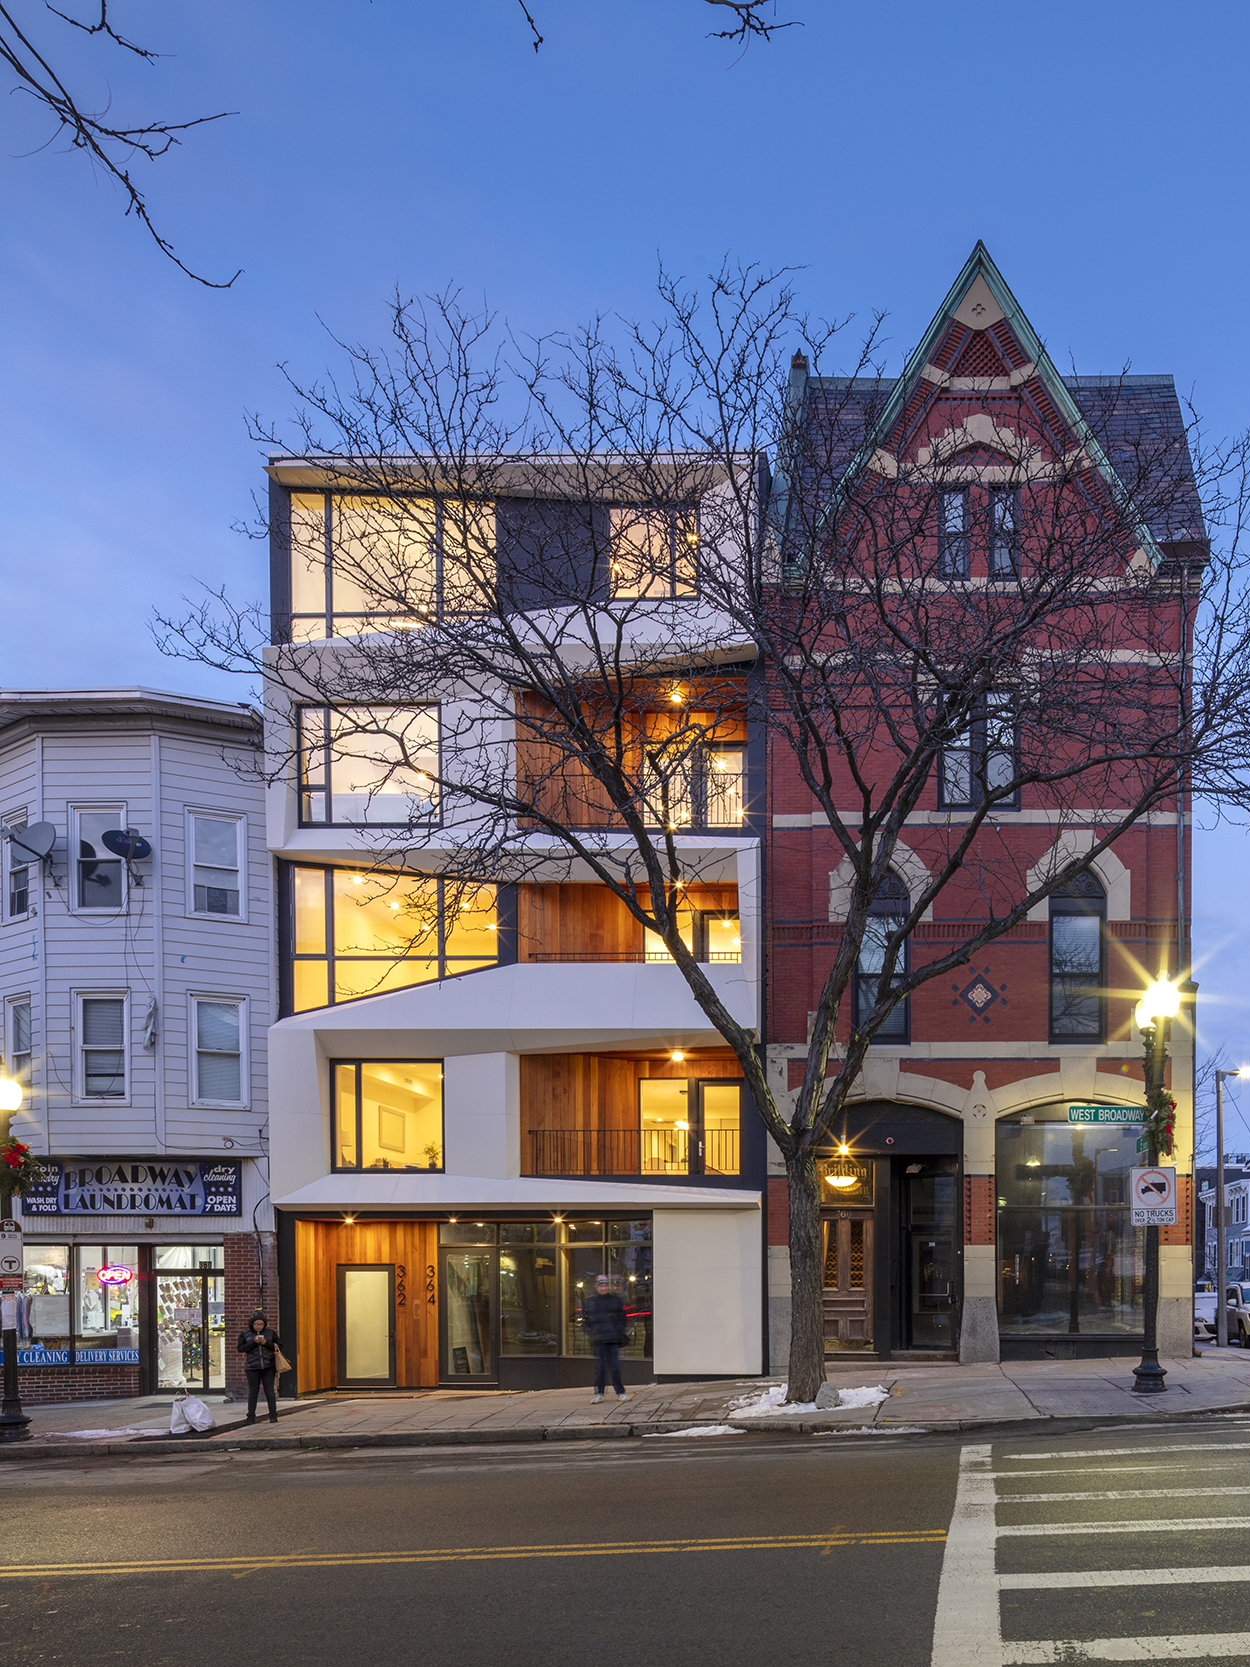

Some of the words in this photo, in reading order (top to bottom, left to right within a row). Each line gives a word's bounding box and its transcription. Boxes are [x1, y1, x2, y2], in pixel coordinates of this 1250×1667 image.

[1071, 1109, 1095, 1120] WEST
[1098, 1109, 1144, 1121] BROADWAY
[214, 1165, 235, 1174] dry
[64, 1164, 198, 1191] BROADWAY
[203, 1168, 236, 1184] cleaning
[64, 1193, 199, 1210] LAUNDROMAT
[207, 1196, 236, 1204] OPEN
[205, 1204, 211, 1212] 7
[214, 1204, 236, 1212] DAYS
[98, 1270, 131, 1280] OPEN
[24, 1351, 68, 1362] CLEANING
[76, 1350, 108, 1362] DELIVERY
[108, 1350, 140, 1362] SERVICES
